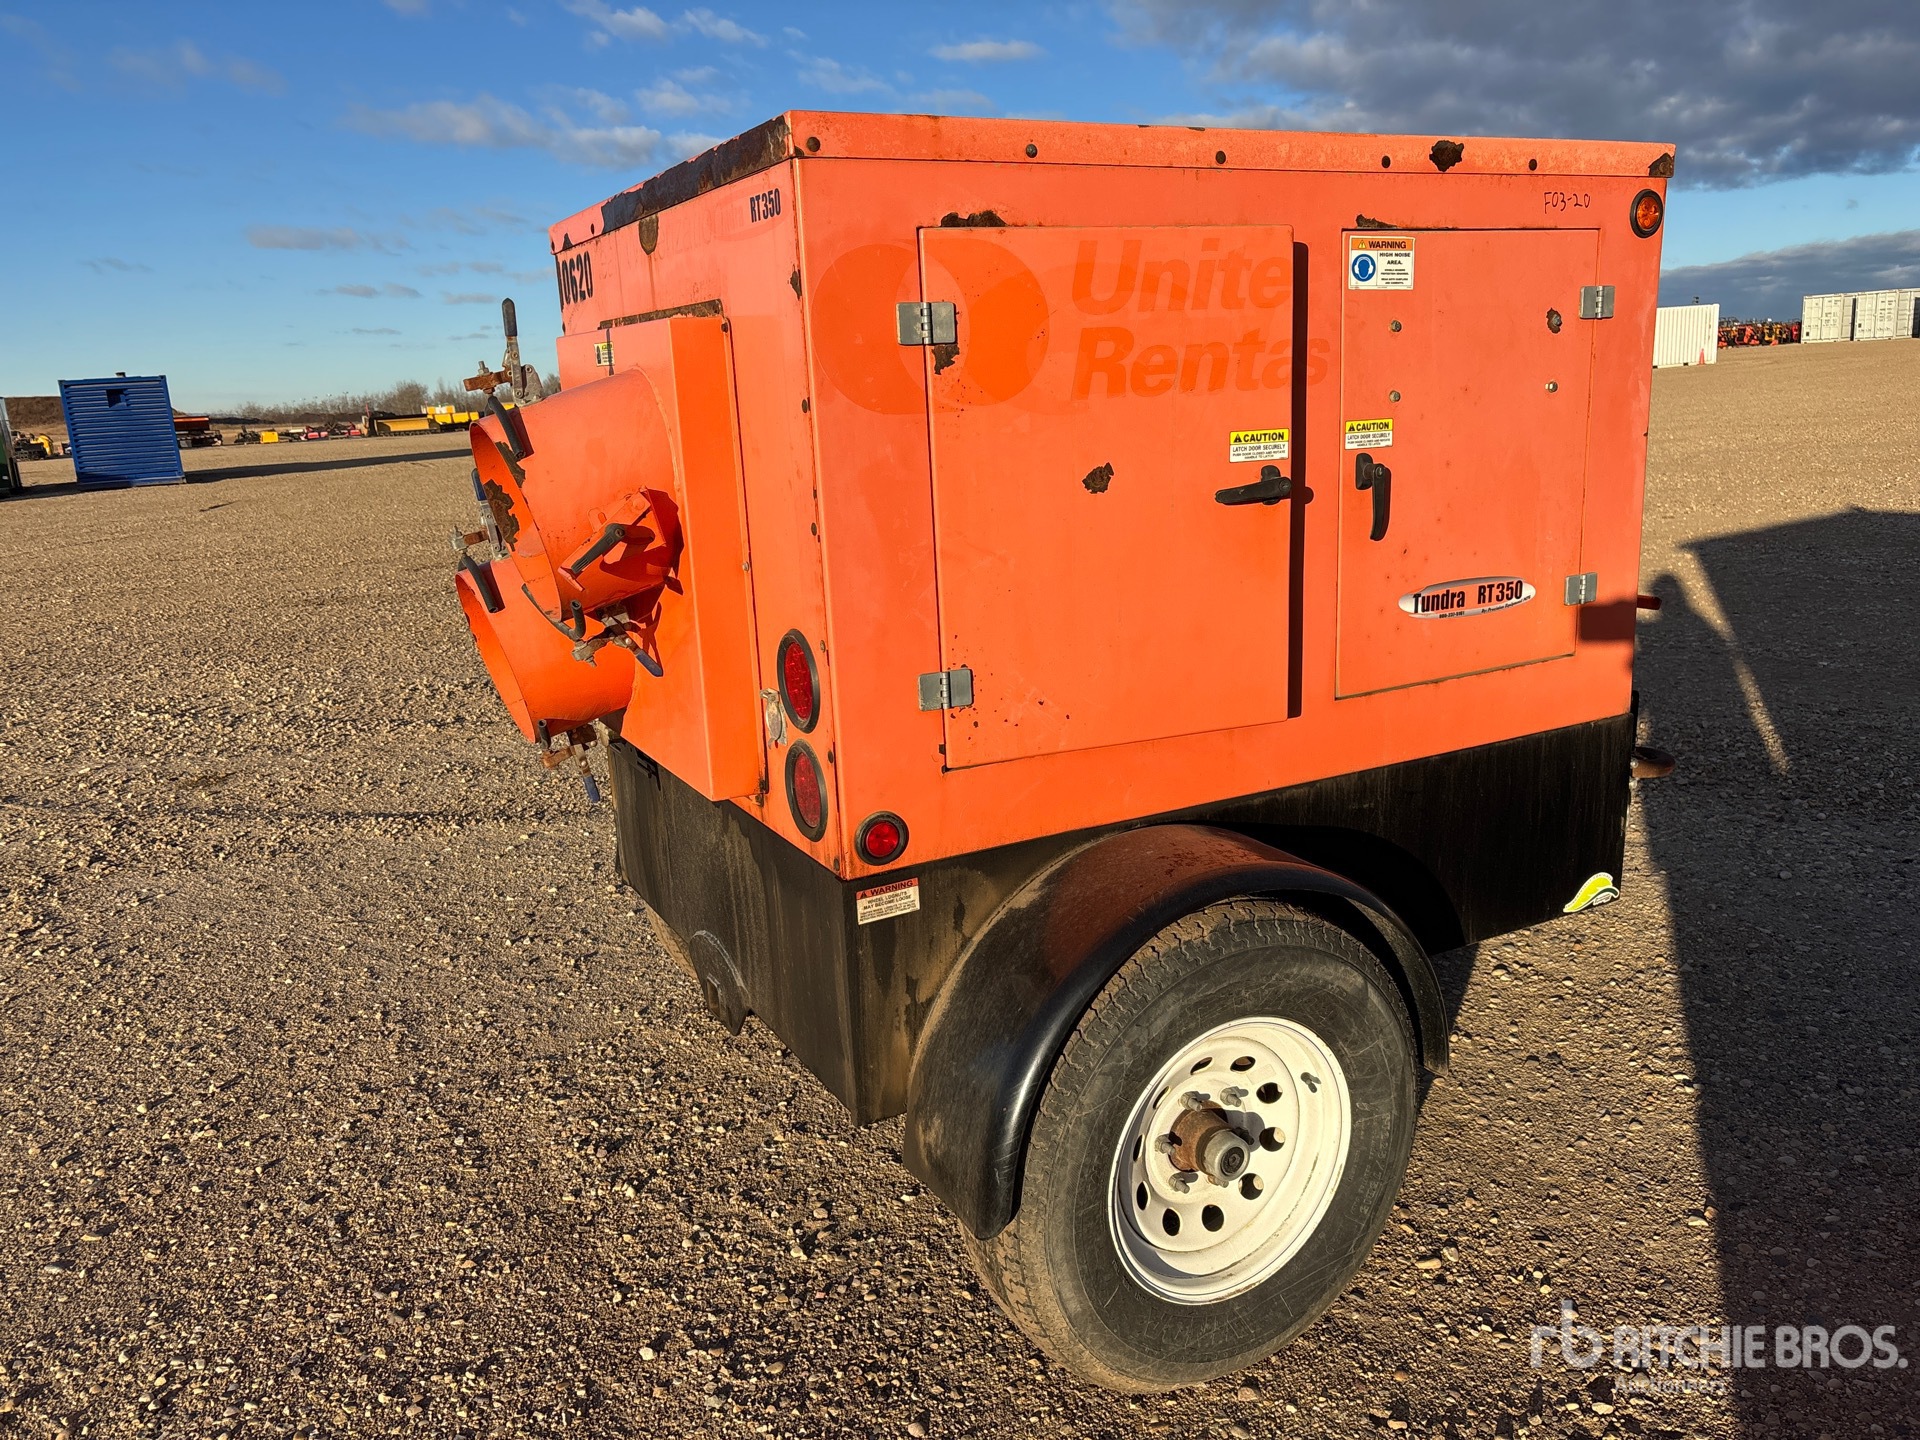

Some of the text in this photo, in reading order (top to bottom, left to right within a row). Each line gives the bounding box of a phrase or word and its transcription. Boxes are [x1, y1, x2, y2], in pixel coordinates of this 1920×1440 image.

[749, 188, 782, 223] RT350
[1543, 191, 1591, 214] F03-20
[1368, 240, 1407, 249] WARNING
[1355, 421, 1390, 431] CAUTION
[1243, 432, 1285, 443] CAUTION
[1262, 443, 1286, 451] SECURELY
[1412, 589, 1466, 614] Tundra
[871, 880, 913, 897] WARNING
